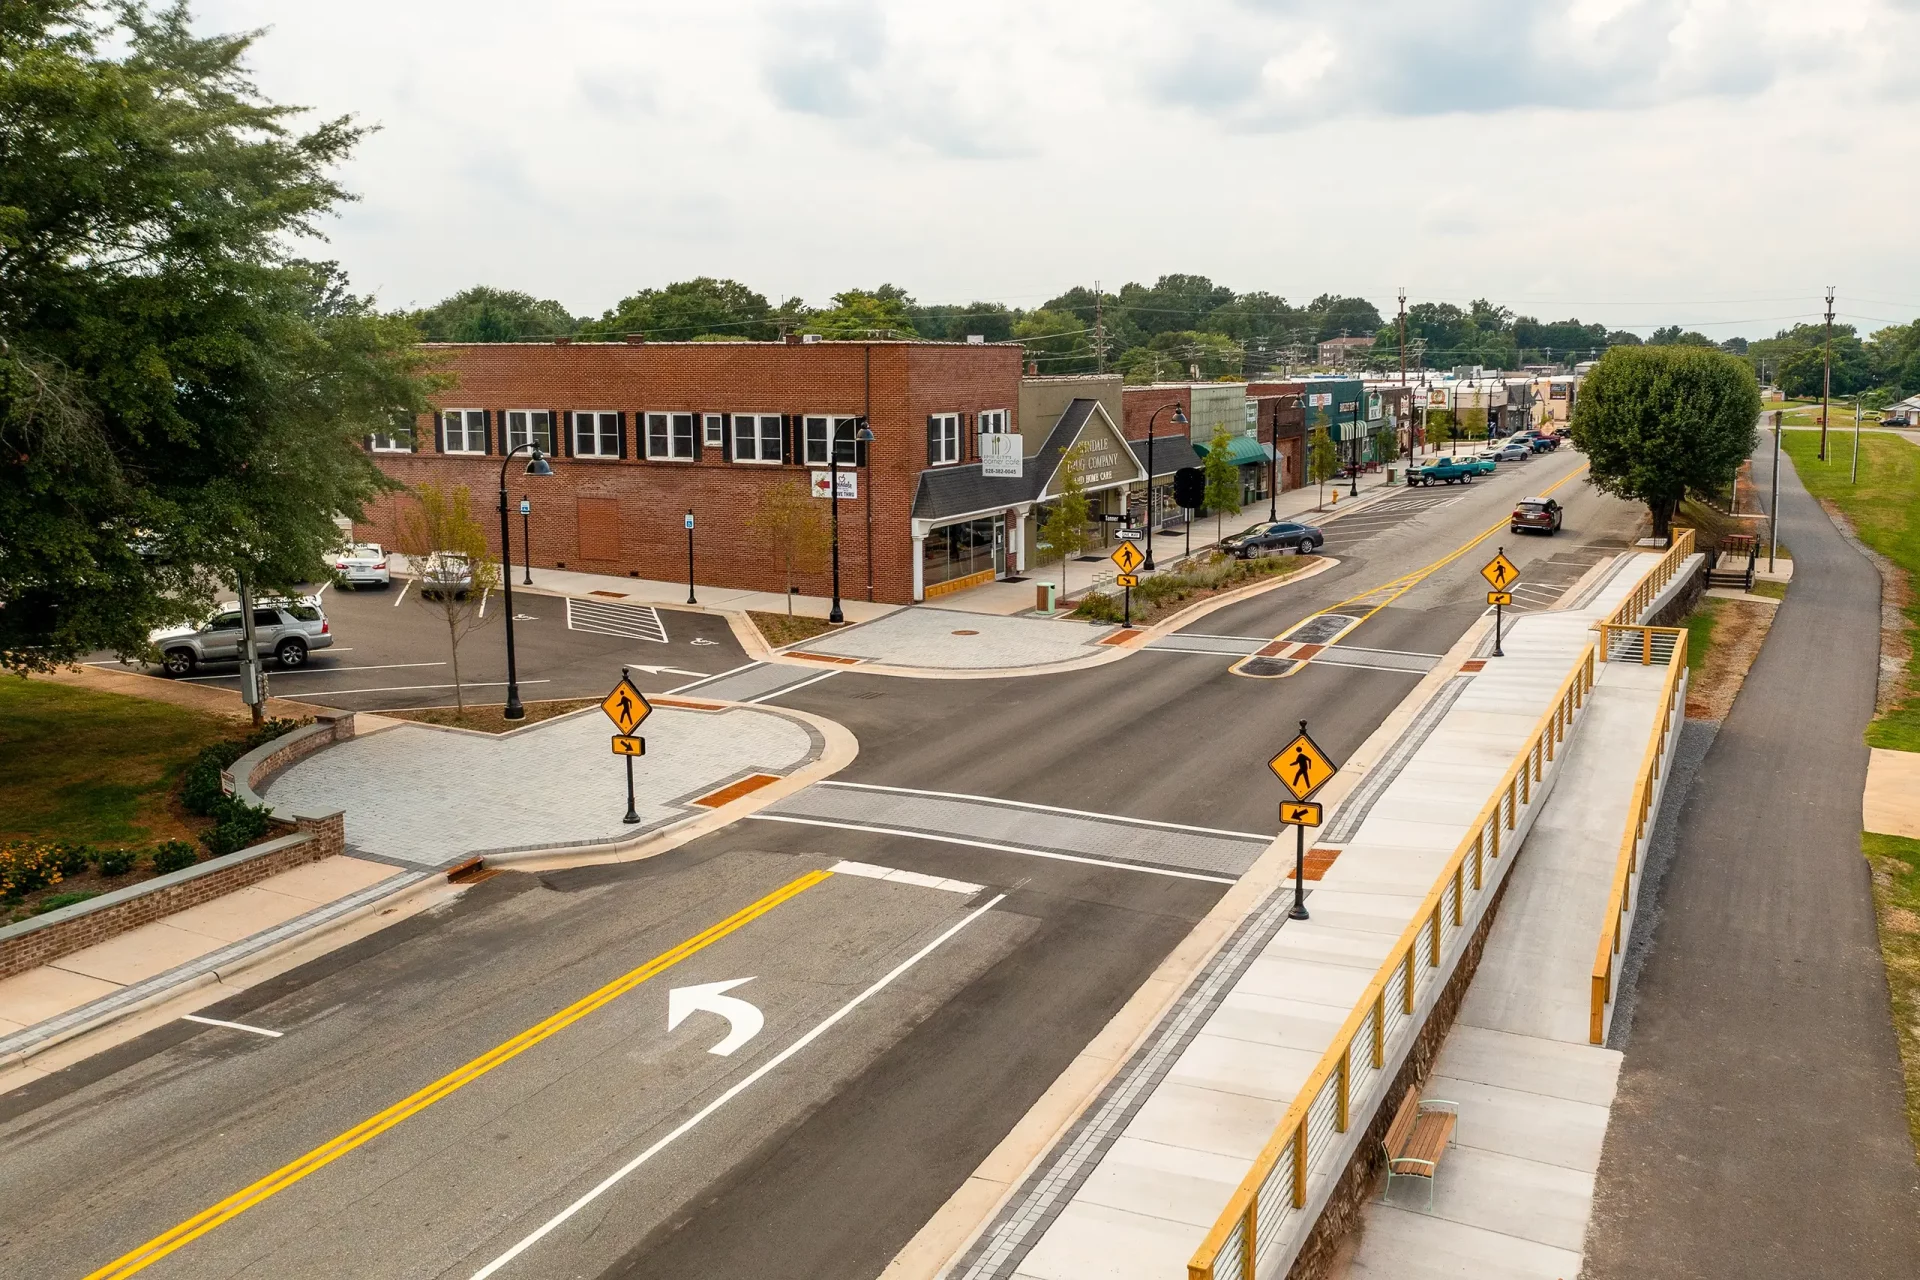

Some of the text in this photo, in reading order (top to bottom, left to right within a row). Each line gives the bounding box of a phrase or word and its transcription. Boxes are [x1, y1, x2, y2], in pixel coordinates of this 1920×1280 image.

[1088, 453, 1118, 470] COMPANY
[1086, 473, 1099, 484] HOME
[1100, 471, 1112, 480] CARE
